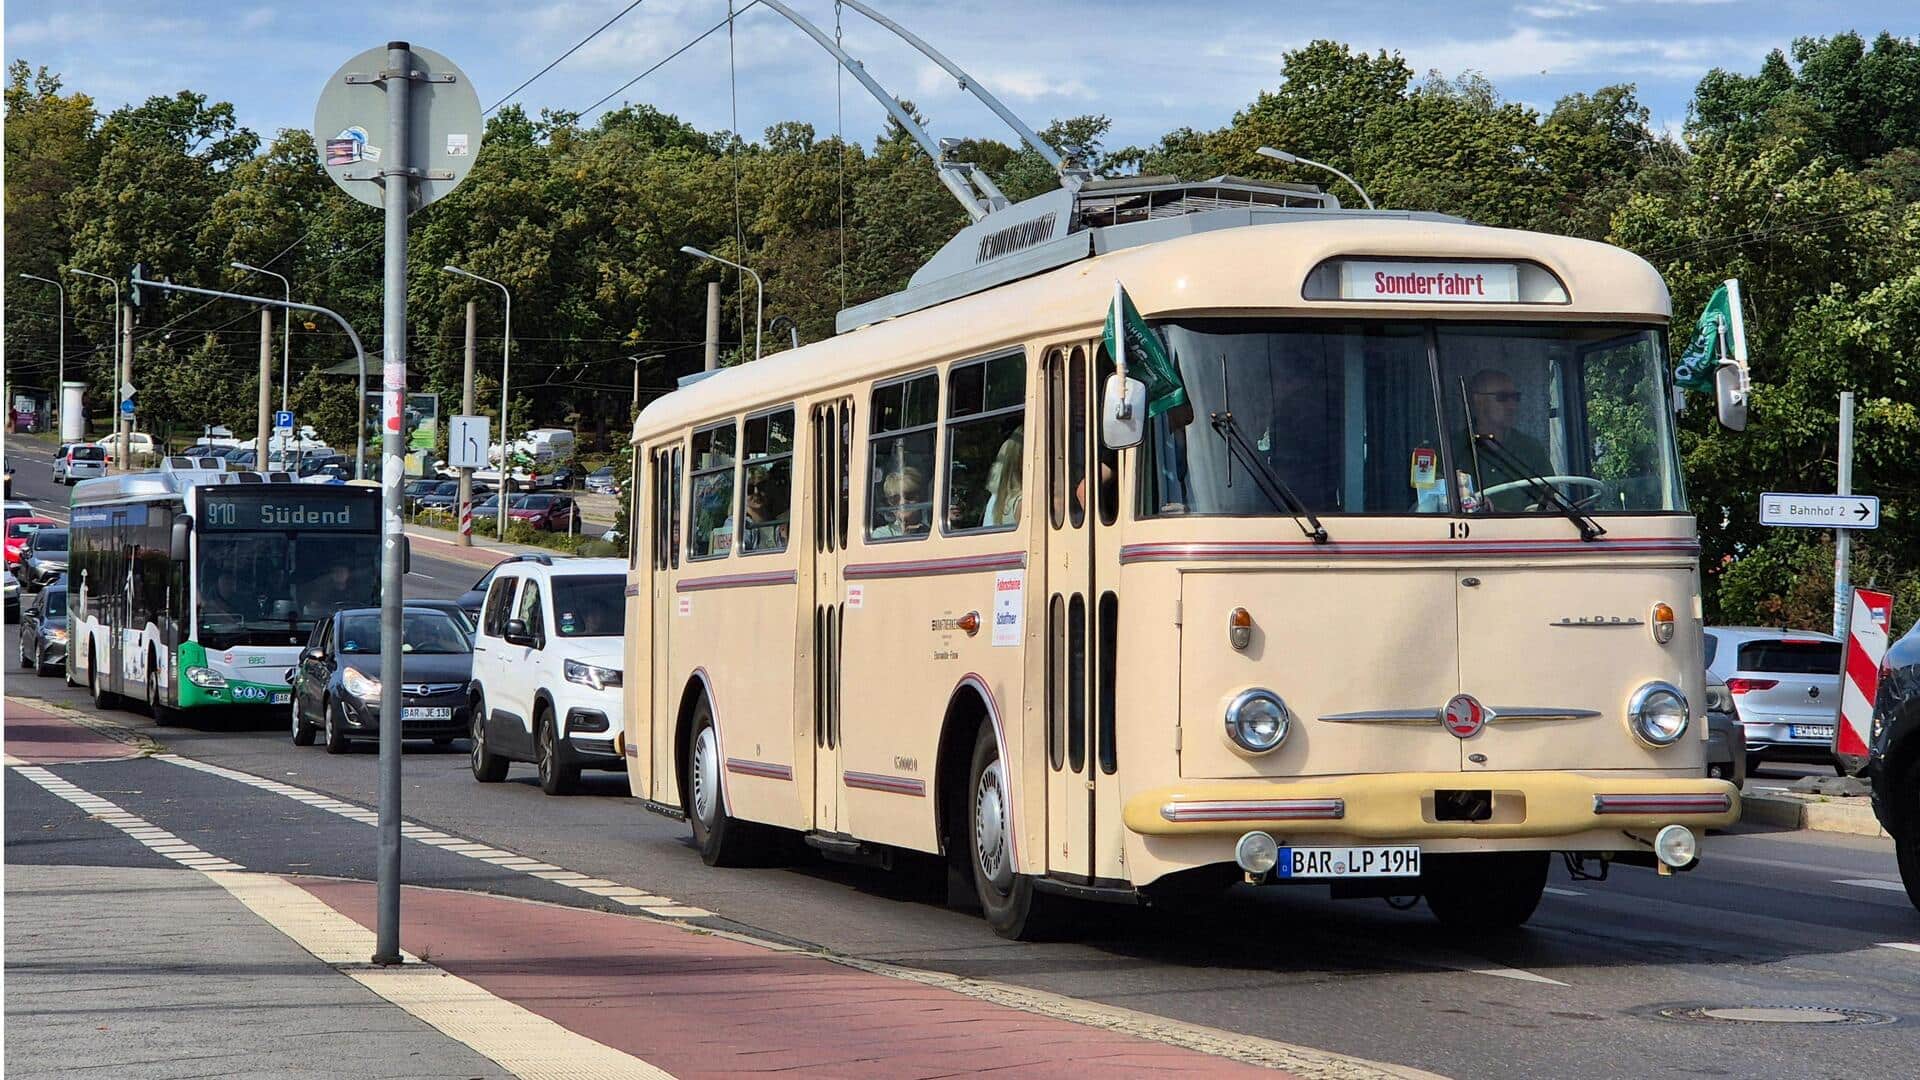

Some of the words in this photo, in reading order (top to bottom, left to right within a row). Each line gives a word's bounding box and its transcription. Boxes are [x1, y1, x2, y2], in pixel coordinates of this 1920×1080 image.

[1375, 271, 1485, 295] Sonderfahrt
[280, 414, 290, 426] P
[208, 503, 236, 524] 910
[261, 505, 350, 524] Südend
[1790, 504, 1834, 516] Bahnhof
[1839, 506, 1846, 516] 2
[1449, 521, 1470, 540] 19
[275, 694, 288, 702] BAR
[404, 709, 419, 717] BAR
[437, 709, 450, 717] 138
[1292, 851, 1332, 873] BAR
[1349, 851, 1374, 873] LP
[1380, 850, 1418, 873] 19H
